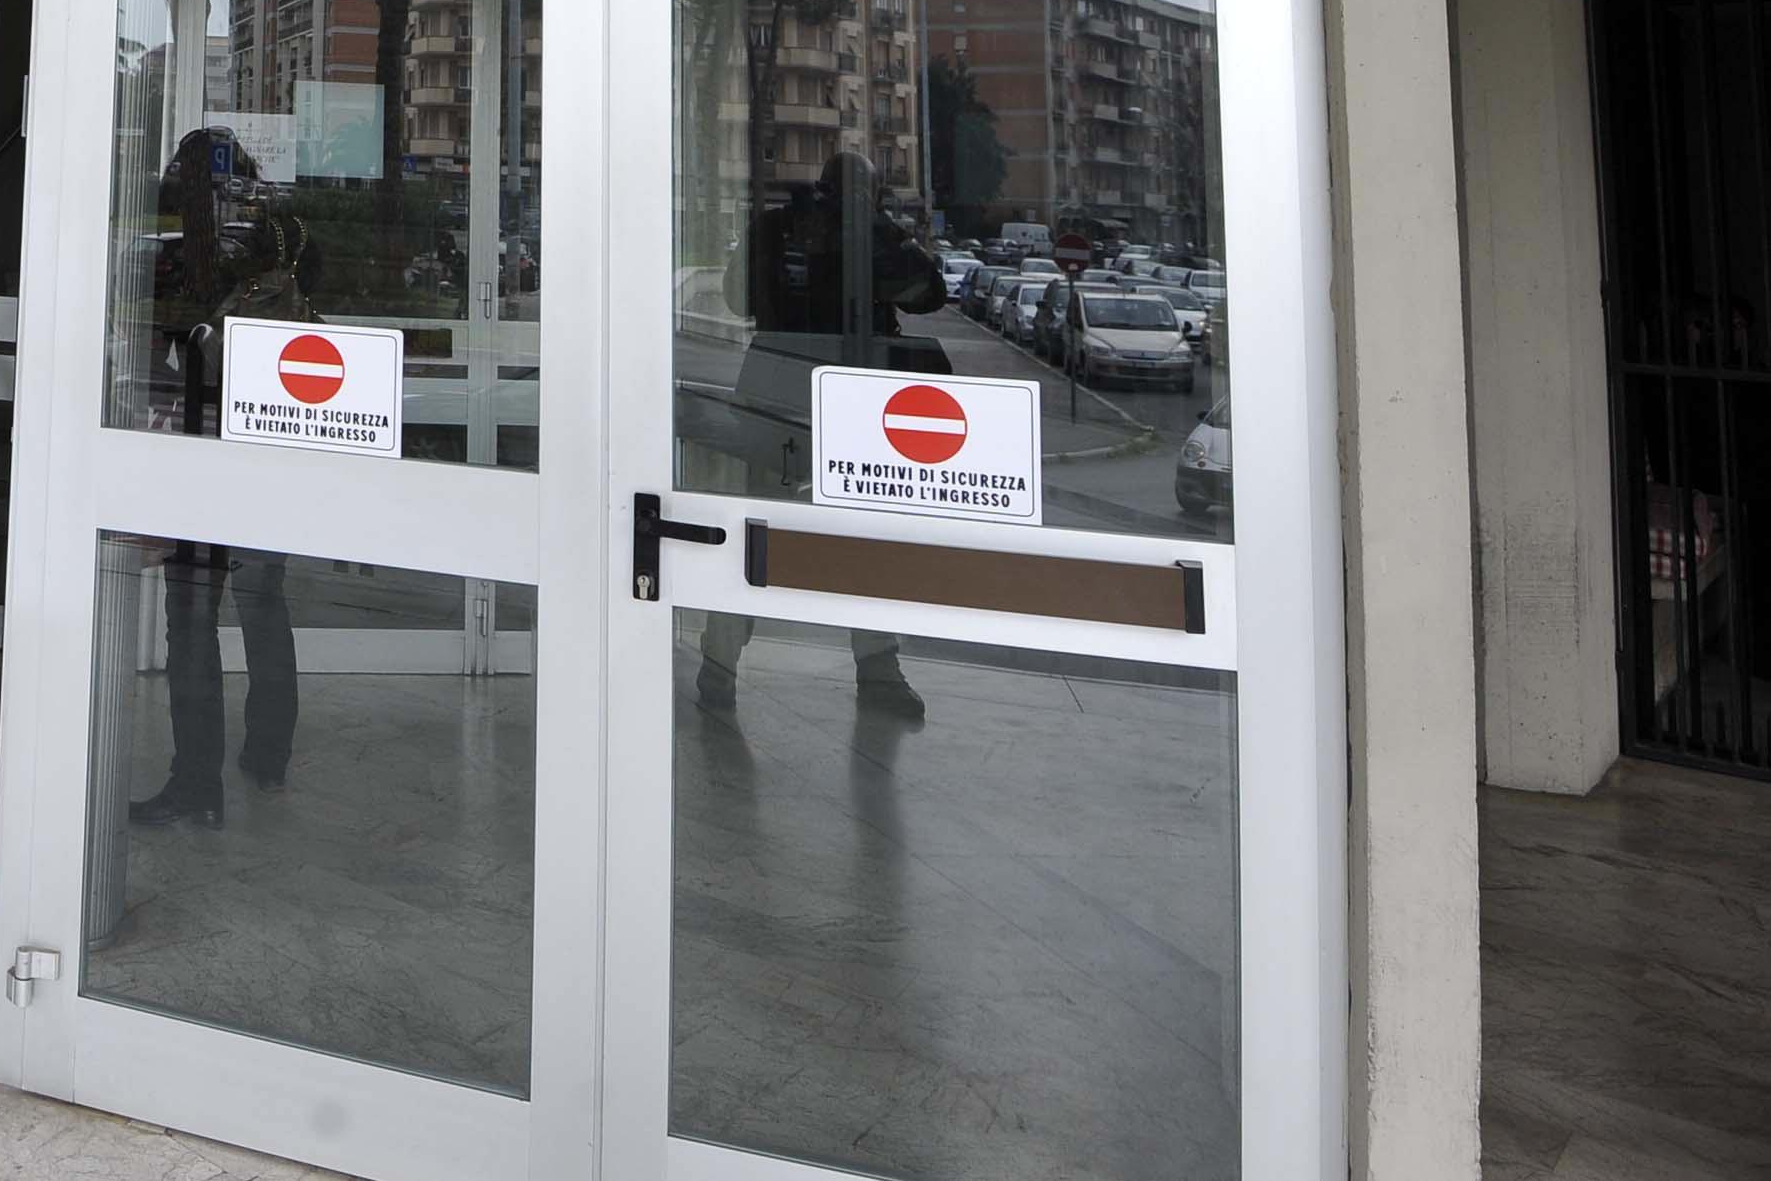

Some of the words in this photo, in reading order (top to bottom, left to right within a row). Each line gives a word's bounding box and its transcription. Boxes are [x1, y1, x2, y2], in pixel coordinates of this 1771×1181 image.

[234, 401, 255, 415] PER
[260, 403, 301, 420] MOTIVI
[305, 407, 317, 421] DI
[322, 409, 389, 428] SICUREZZA
[245, 415, 251, 430] È
[255, 419, 300, 435] VIETATO
[305, 424, 376, 443] L'INGRESSO
[829, 460, 855, 475] PER
[861, 462, 913, 481] MOTIVI
[919, 468, 934, 483] DI
[941, 470, 1026, 492] SICUREZZA
[843, 476, 850, 493] È
[856, 480, 914, 499] VIETATO
[920, 486, 1010, 508] L'INGRESSO
